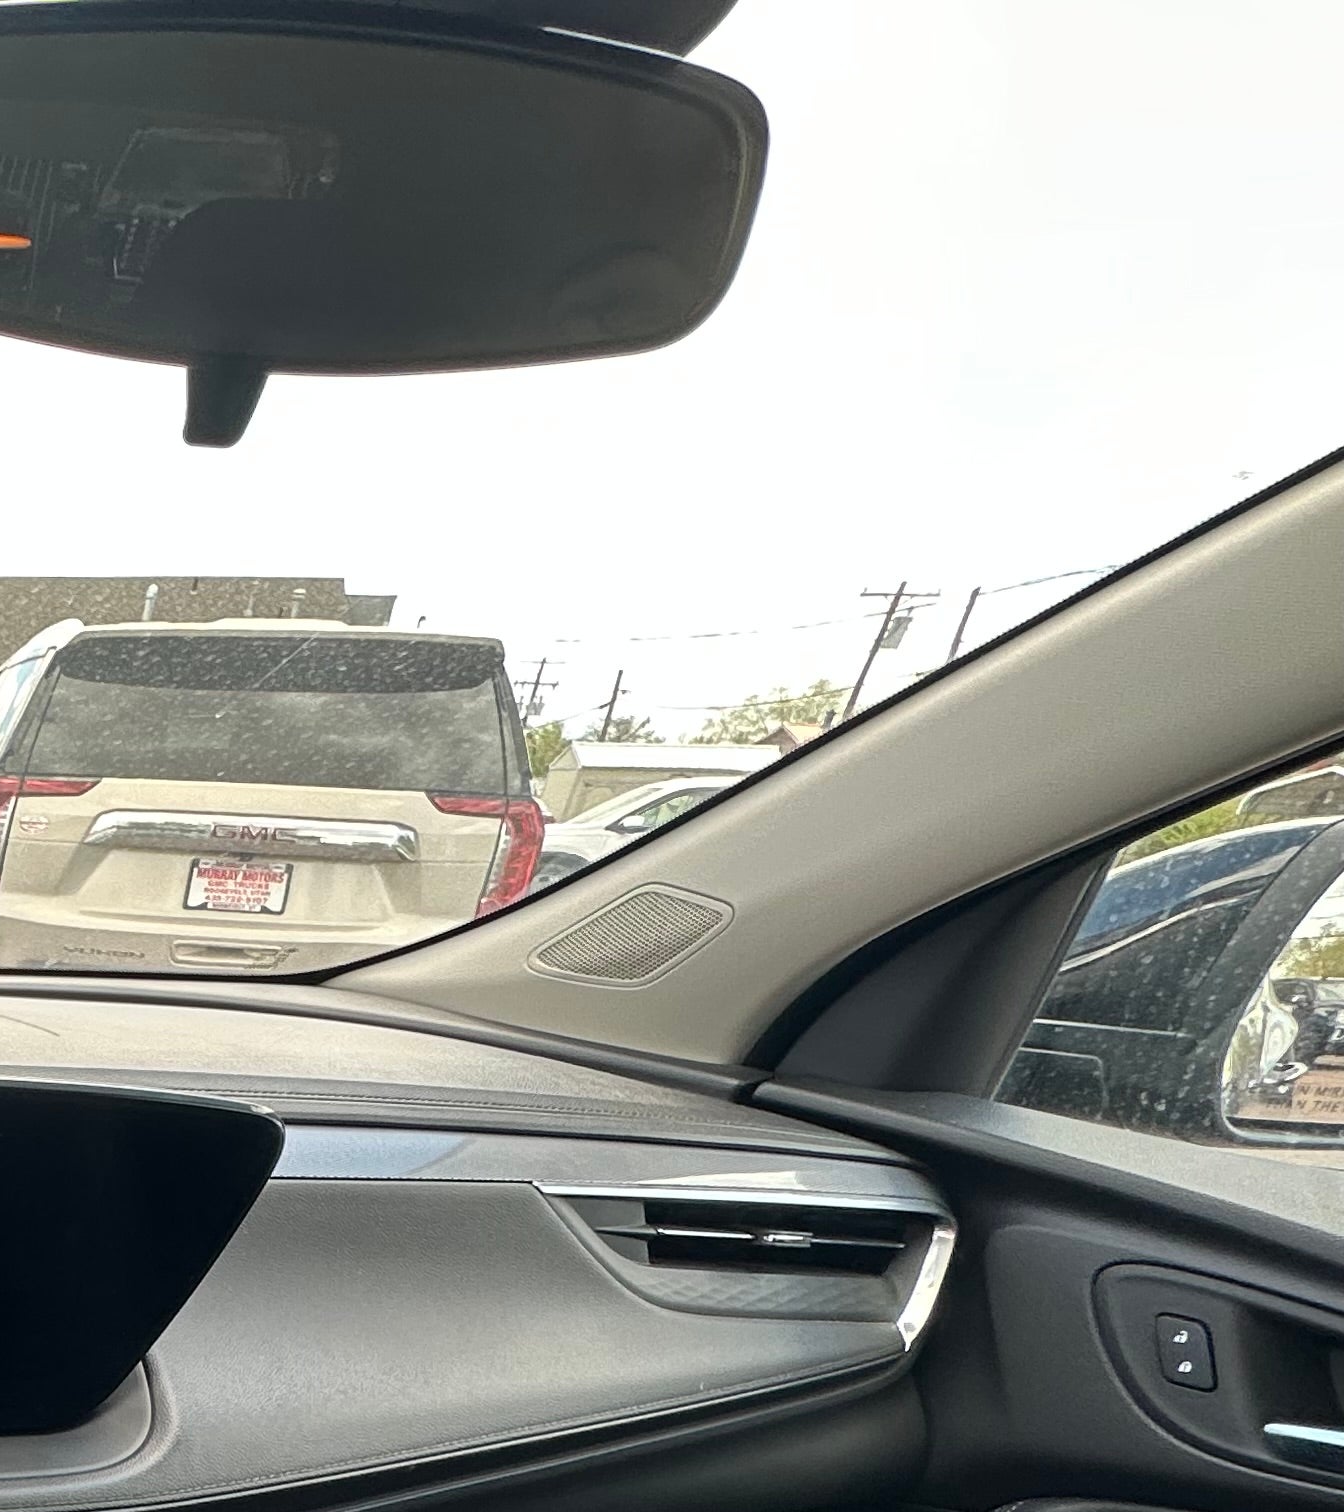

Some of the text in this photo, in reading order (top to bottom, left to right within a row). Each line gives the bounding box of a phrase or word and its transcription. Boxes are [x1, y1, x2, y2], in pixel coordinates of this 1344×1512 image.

[210, 824, 296, 843] GMC
[197, 868, 285, 883] MURRAY MOTORS
